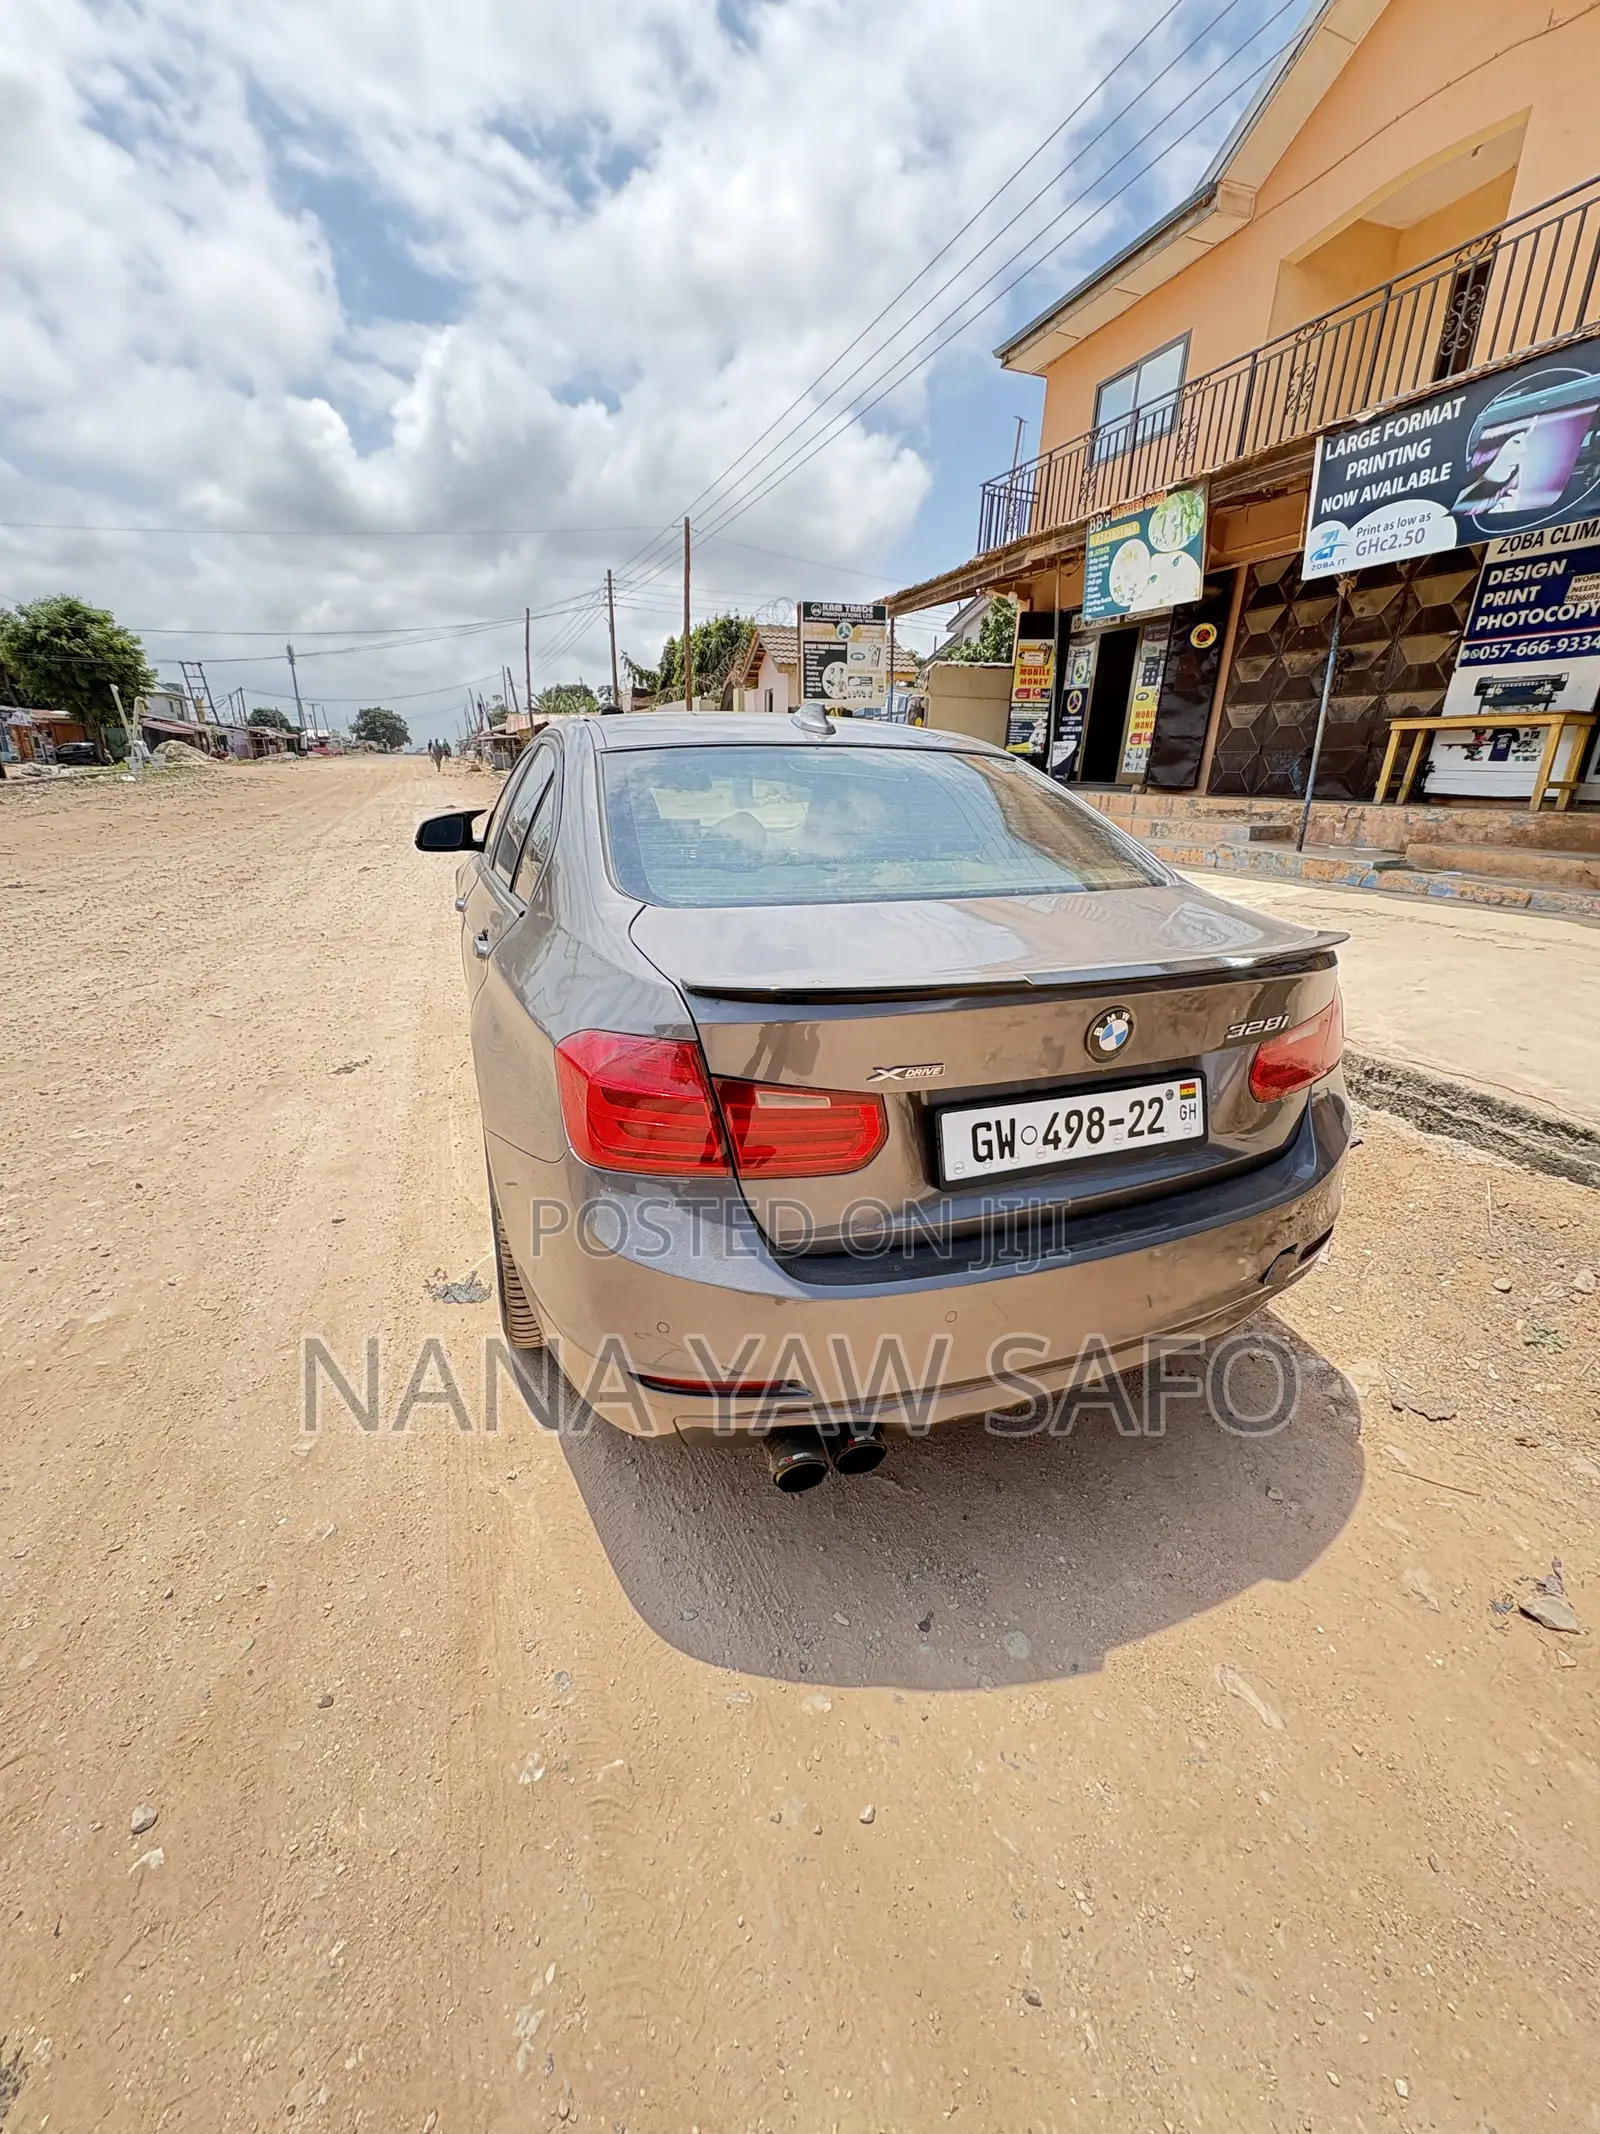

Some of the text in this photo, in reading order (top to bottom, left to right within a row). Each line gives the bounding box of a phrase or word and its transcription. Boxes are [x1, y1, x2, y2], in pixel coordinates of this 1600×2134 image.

[1325, 396, 1466, 461] LARGE FORMAT
[1346, 438, 1432, 481] PRINTING
[1320, 462, 1453, 514] NOW AVAILABLE
[1089, 513, 1111, 534] BB's
[1356, 512, 1431, 538] Print as low as
[1356, 527, 1425, 556] GHc2.50
[1497, 530, 1545, 555] ZOBA
[1311, 558, 1347, 571] ZOBA IT
[1487, 559, 1568, 586] DESIGN
[845, 605, 874, 614] TRADE
[1481, 585, 1542, 608] PRINT
[1094, 1011, 1130, 1037] BMW
[1226, 1014, 1289, 1040] 328i
[1179, 1102, 1197, 1121] GH
[971, 1096, 1165, 1163] GW 498-22
